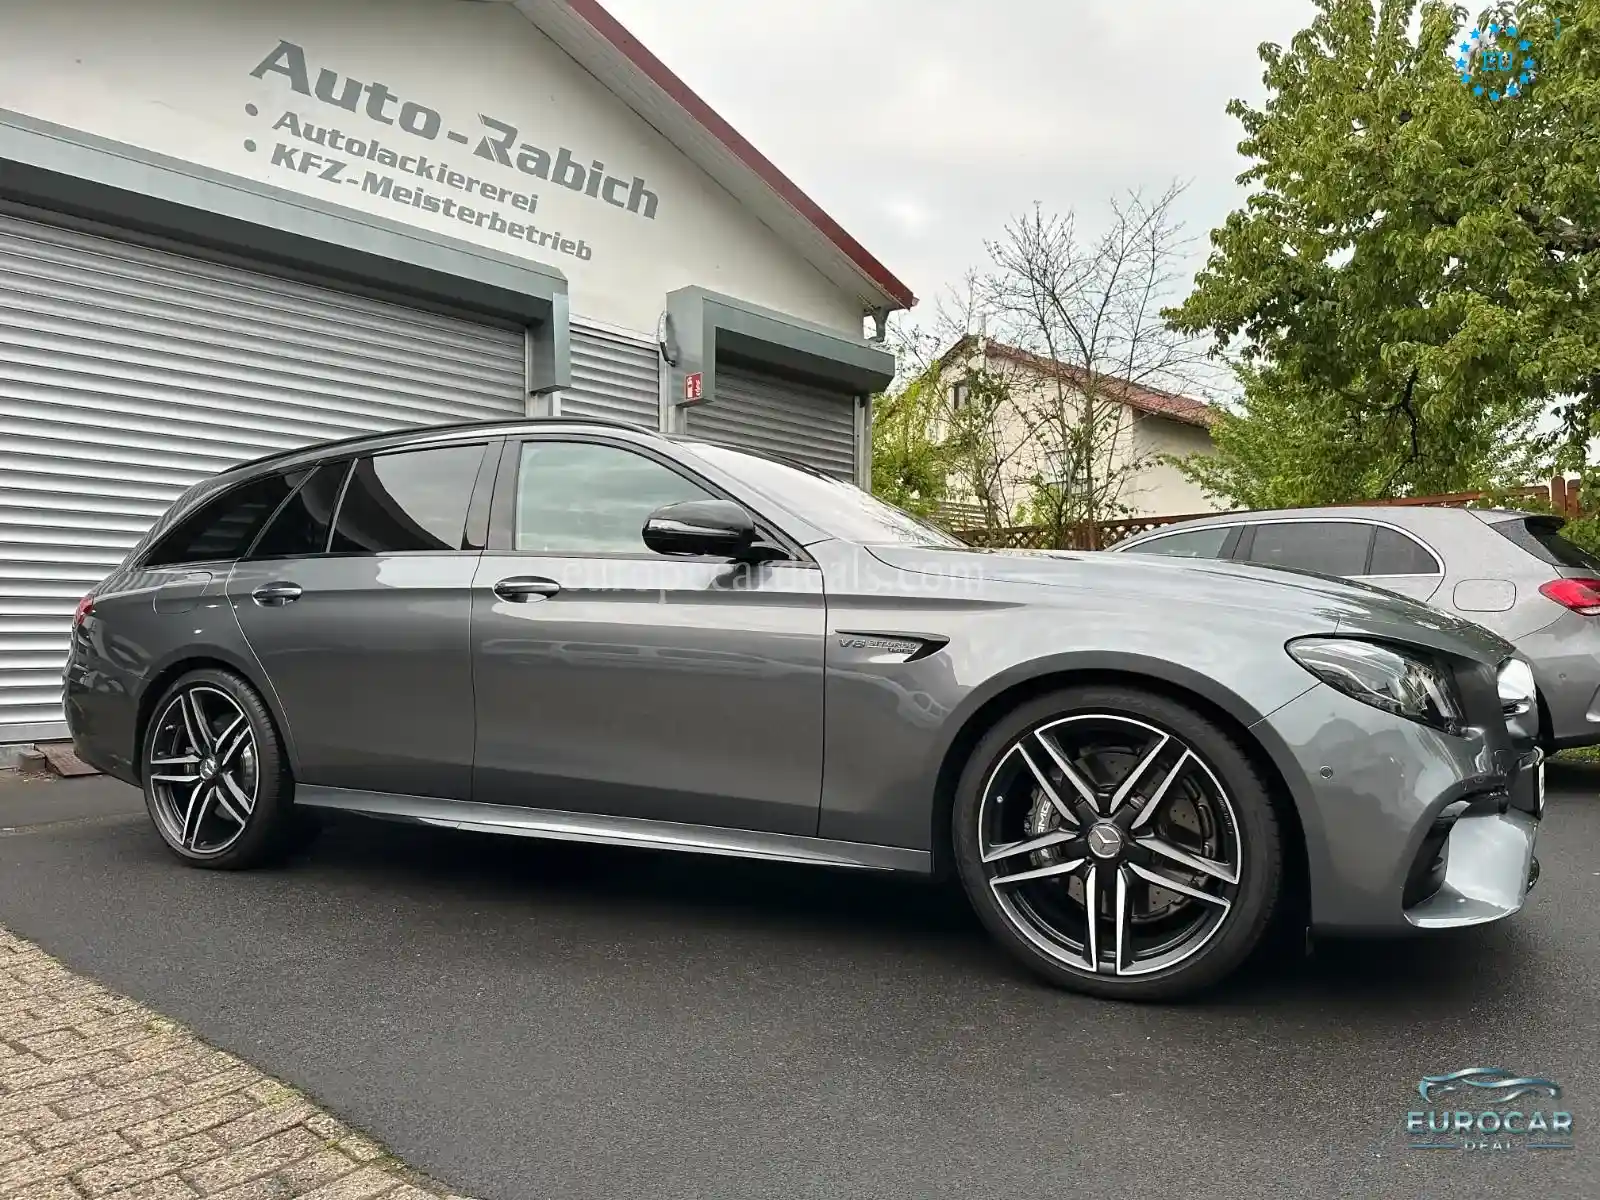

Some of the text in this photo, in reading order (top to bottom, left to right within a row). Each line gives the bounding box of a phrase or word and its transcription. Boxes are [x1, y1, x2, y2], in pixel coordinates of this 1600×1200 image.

[249, 39, 659, 219] Auto-Rabich
[271, 110, 539, 214] Autolackiererei
[270, 143, 592, 260] KFZ-Meisterbetrieb
[839, 639, 866, 648] V8
